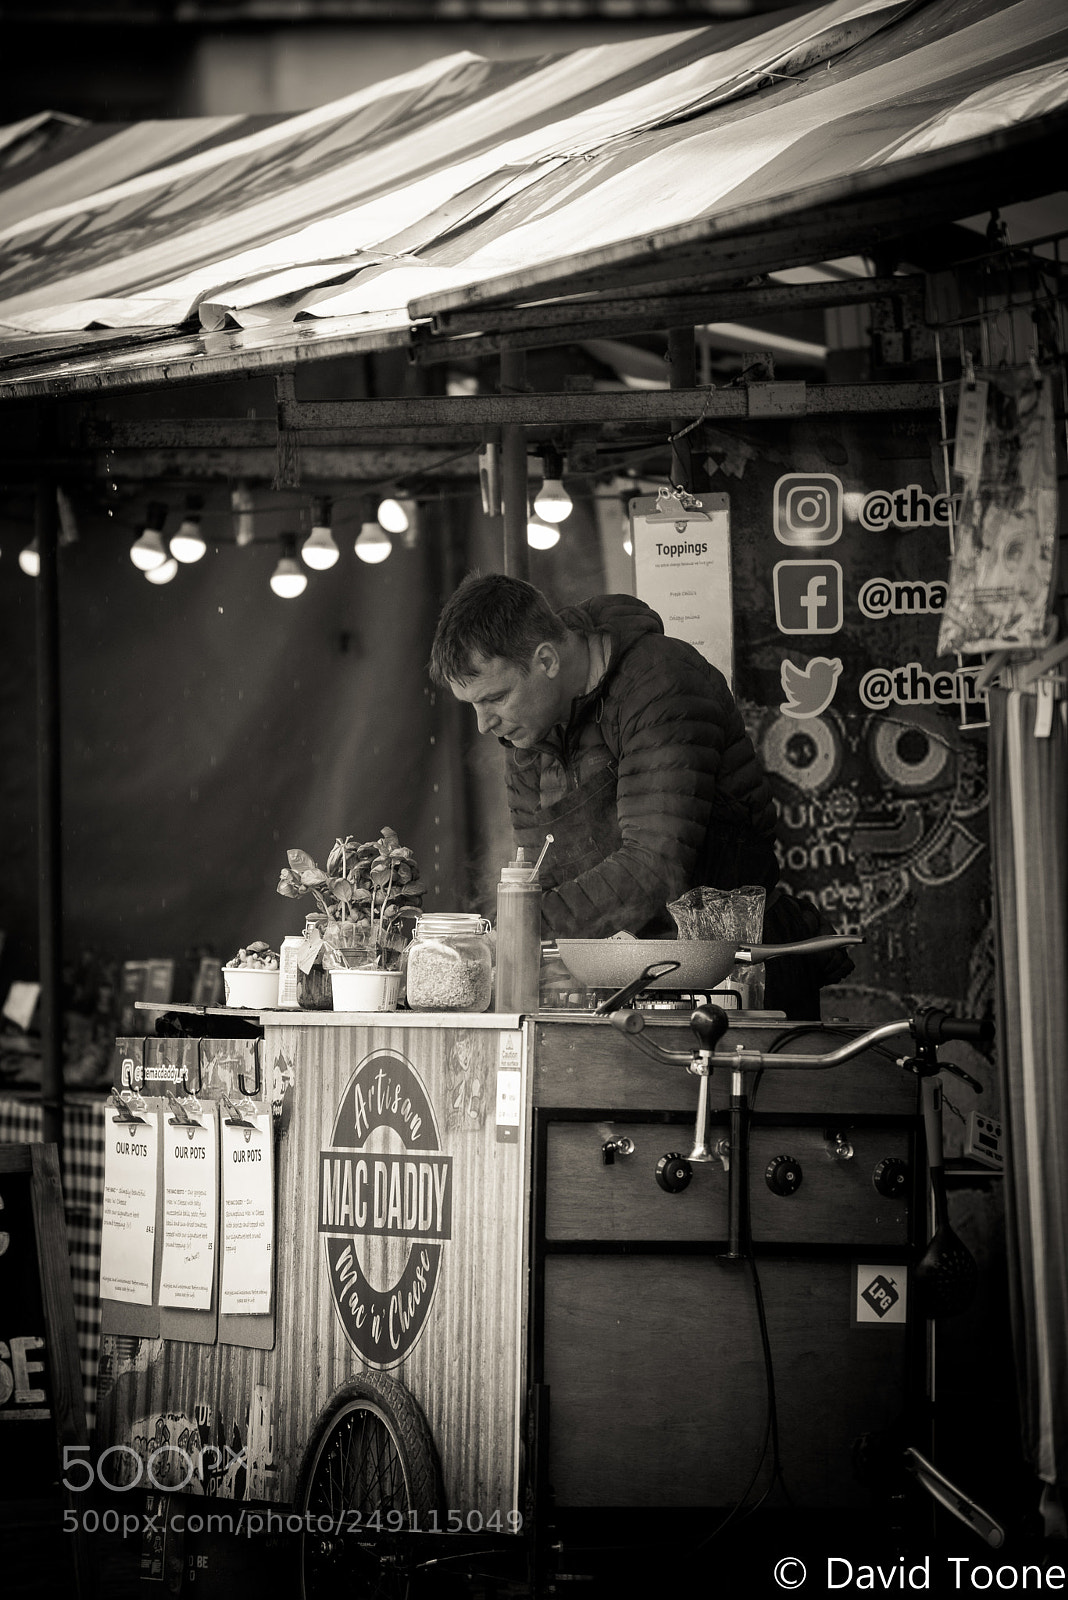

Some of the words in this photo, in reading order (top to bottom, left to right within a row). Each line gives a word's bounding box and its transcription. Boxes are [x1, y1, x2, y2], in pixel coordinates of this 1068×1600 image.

[655, 541, 708, 557] Toppings
[354, 1068, 420, 1141] Artisan
[116, 1142, 130, 1156] OUR
[131, 1143, 147, 1157] POTS
[175, 1146, 189, 1159] OUR
[190, 1147, 205, 1159] POTS
[233, 1151, 246, 1163] OUR
[246, 1149, 261, 1162] POTS
[322, 1159, 368, 1228] MAC
[373, 1161, 449, 1231] DADDY
[335, 1244, 367, 1328] Mac
[388, 1249, 431, 1350] Cheese
[867, 1281, 892, 1310] LPG
